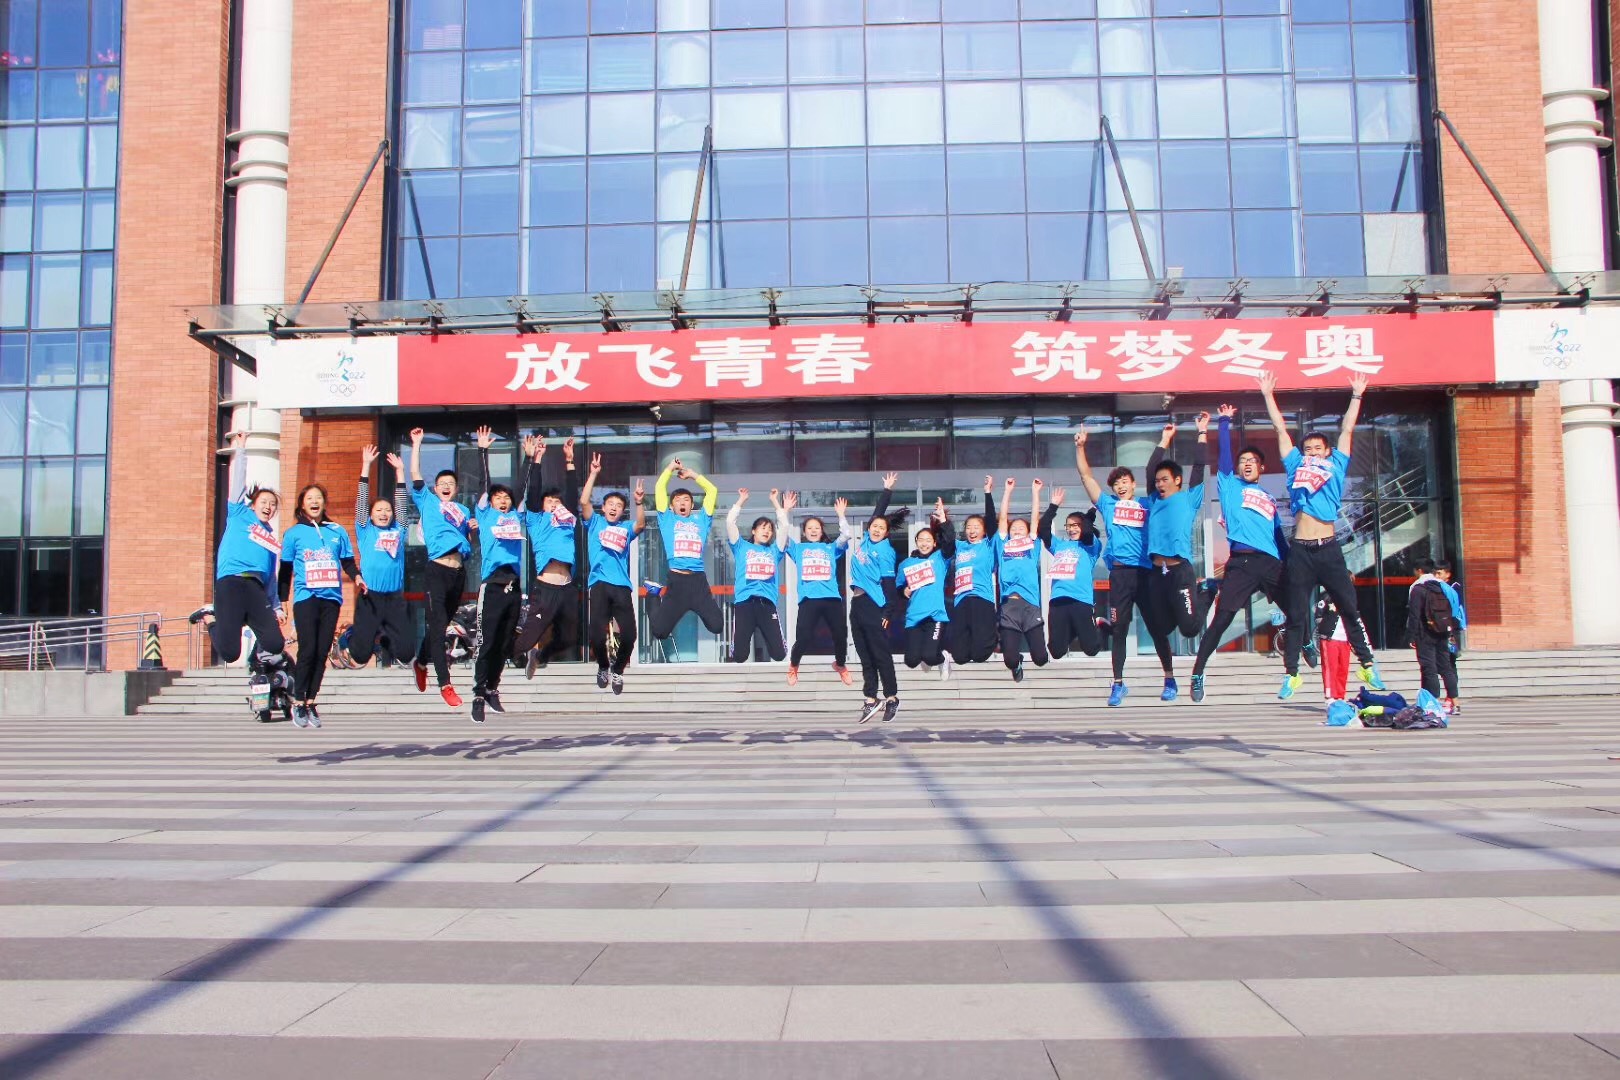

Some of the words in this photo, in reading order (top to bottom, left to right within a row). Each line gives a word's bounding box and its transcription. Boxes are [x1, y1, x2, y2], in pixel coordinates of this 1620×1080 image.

[505, 333, 873, 391] 放飞青春
[1009, 325, 1384, 382] 筑梦冬奥
